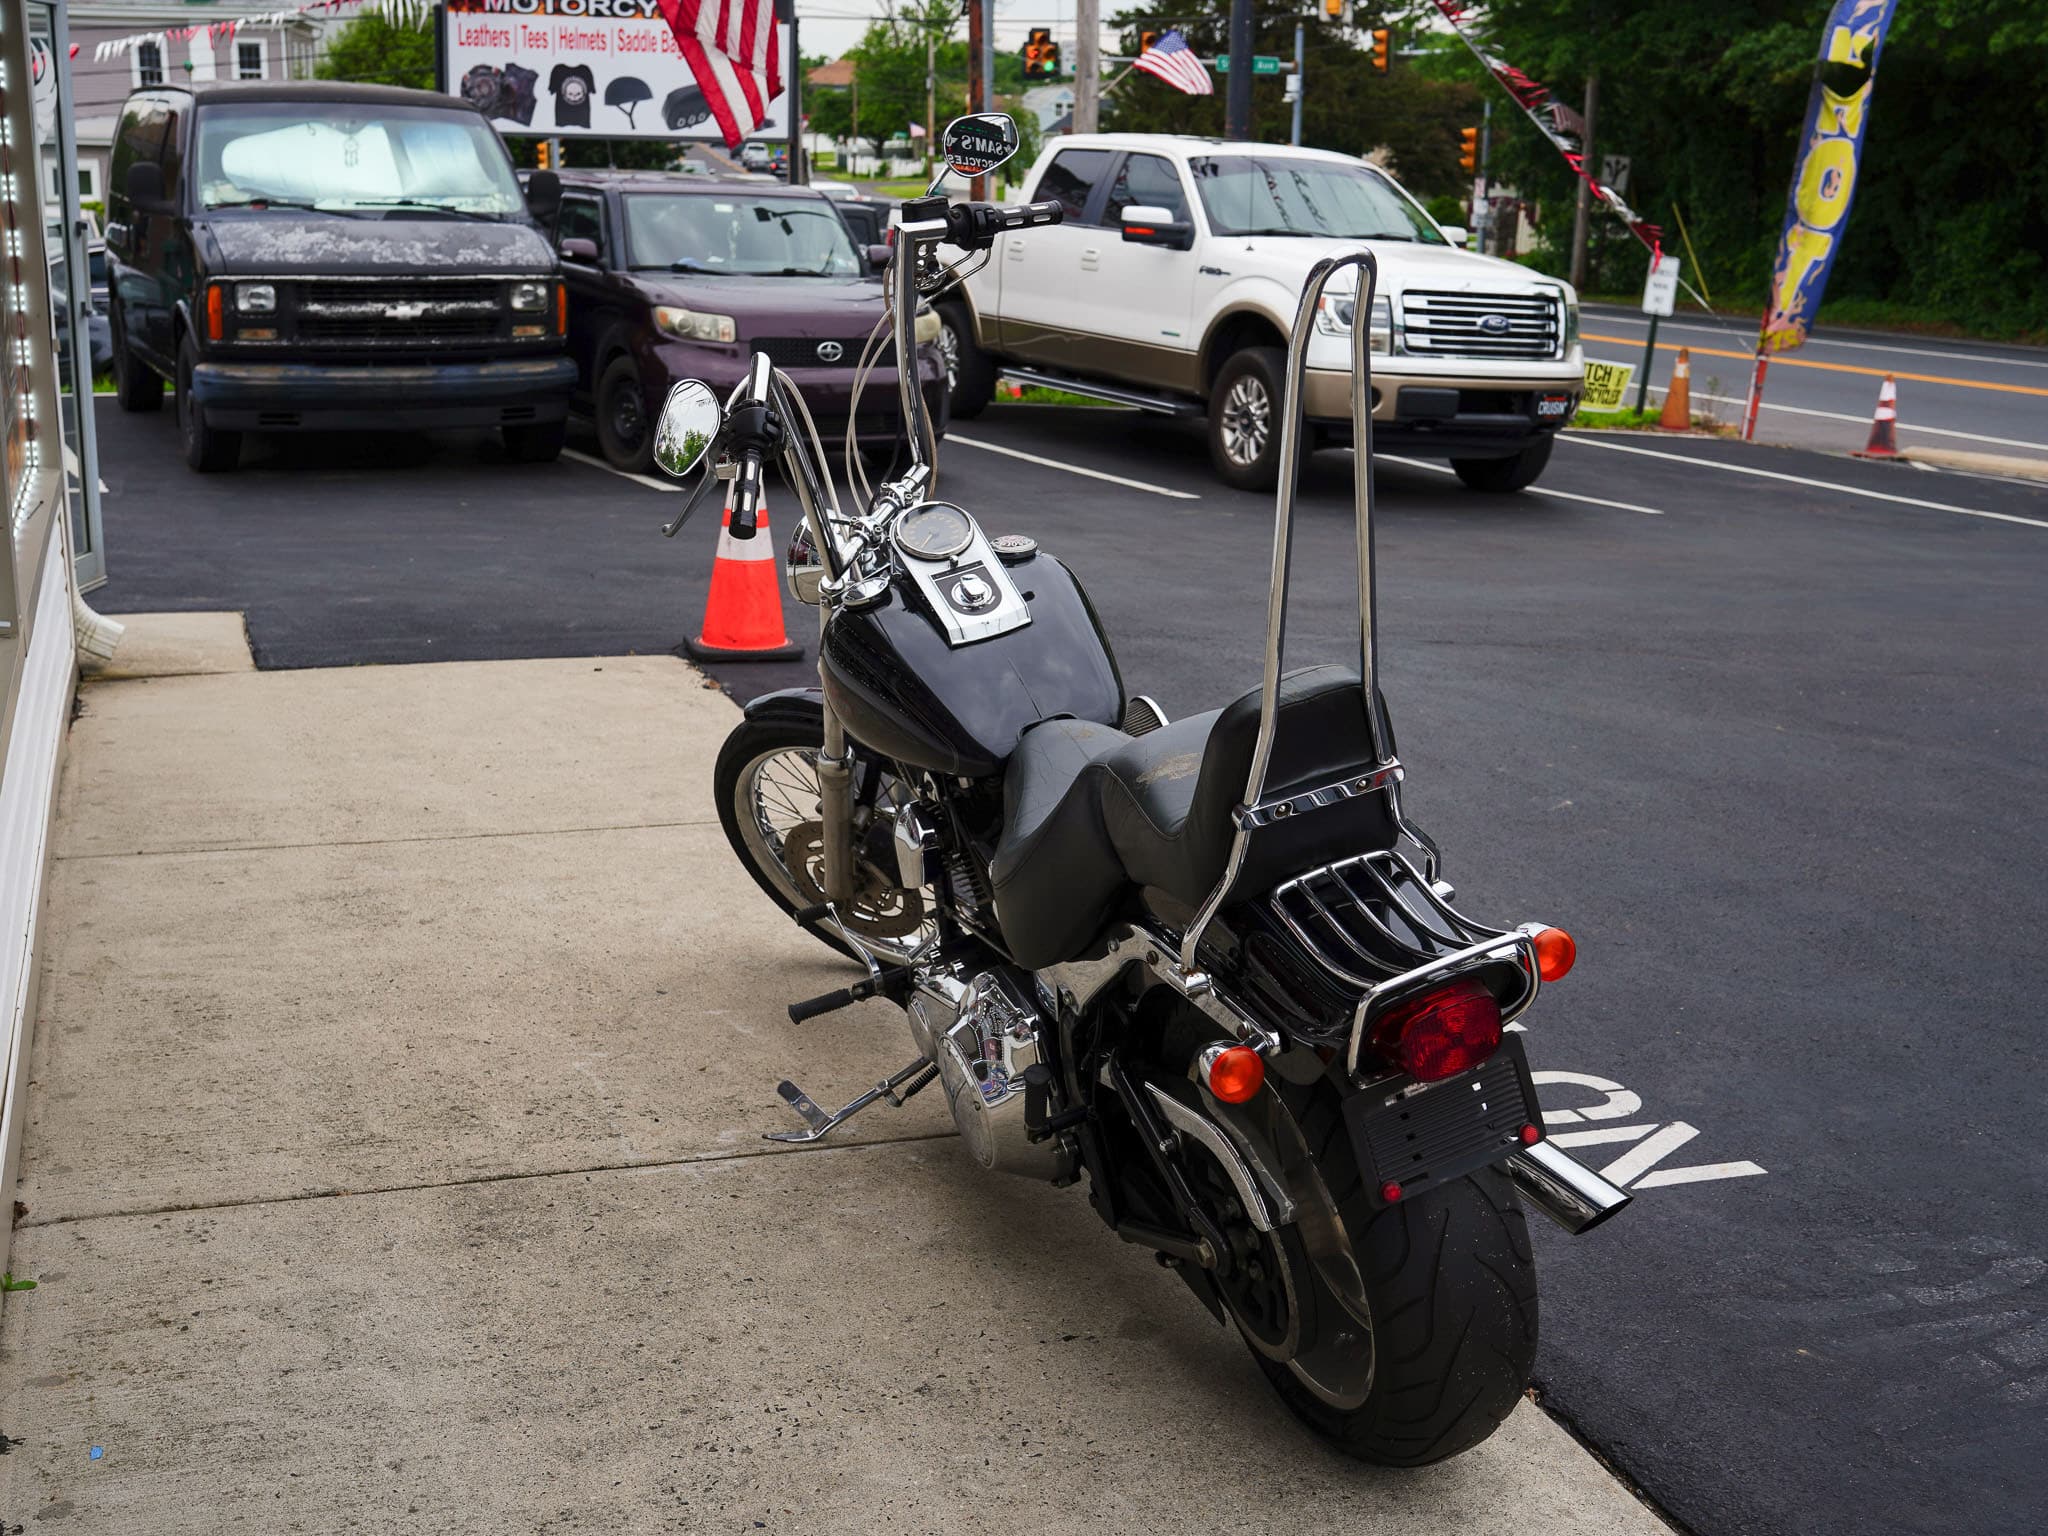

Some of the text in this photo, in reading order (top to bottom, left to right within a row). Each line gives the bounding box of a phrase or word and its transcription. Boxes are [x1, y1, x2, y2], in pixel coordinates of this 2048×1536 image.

[484, 0, 659, 18] MOTORCY
[458, 22, 511, 48] Leathers
[521, 25, 548, 49] Tees
[559, 26, 606, 51] Helmets
[617, 28, 657, 52] Saddle
[1584, 363, 1613, 382] TCH
